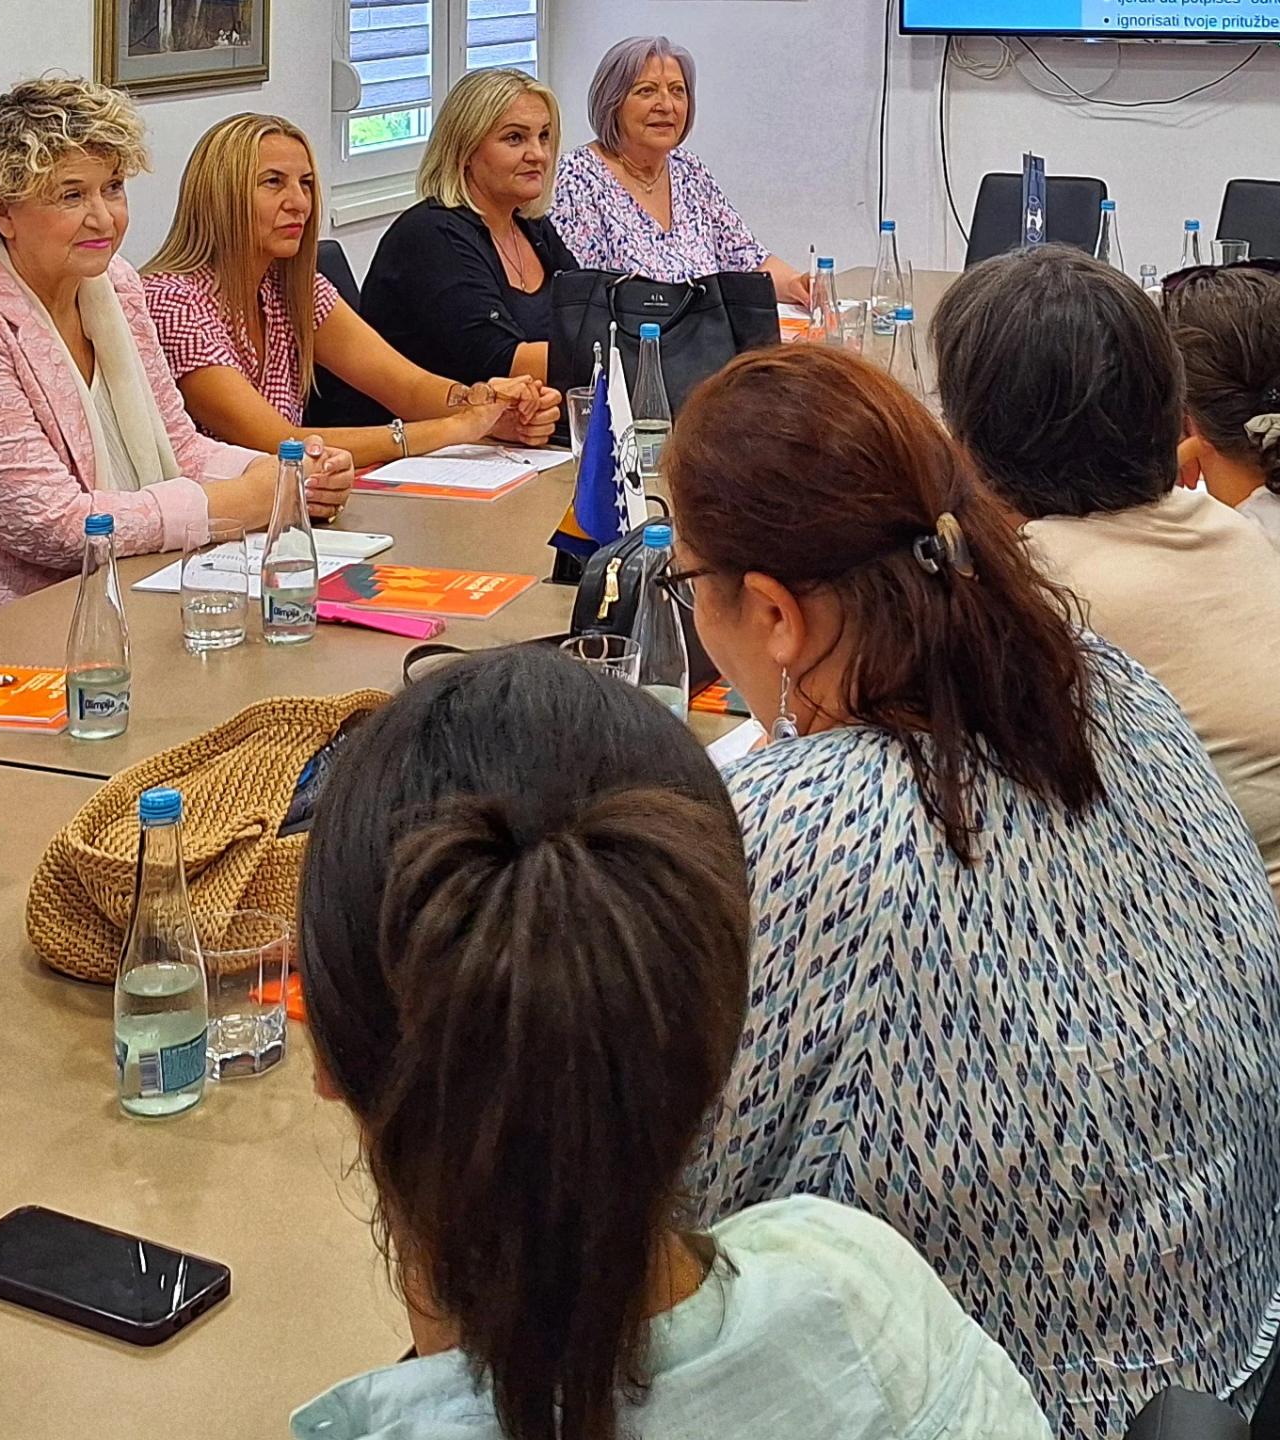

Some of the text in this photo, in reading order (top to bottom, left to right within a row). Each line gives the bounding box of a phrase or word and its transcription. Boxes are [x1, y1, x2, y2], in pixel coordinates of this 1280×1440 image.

[1117, 13, 1280, 29] ignorisati tvoje pritužbe
